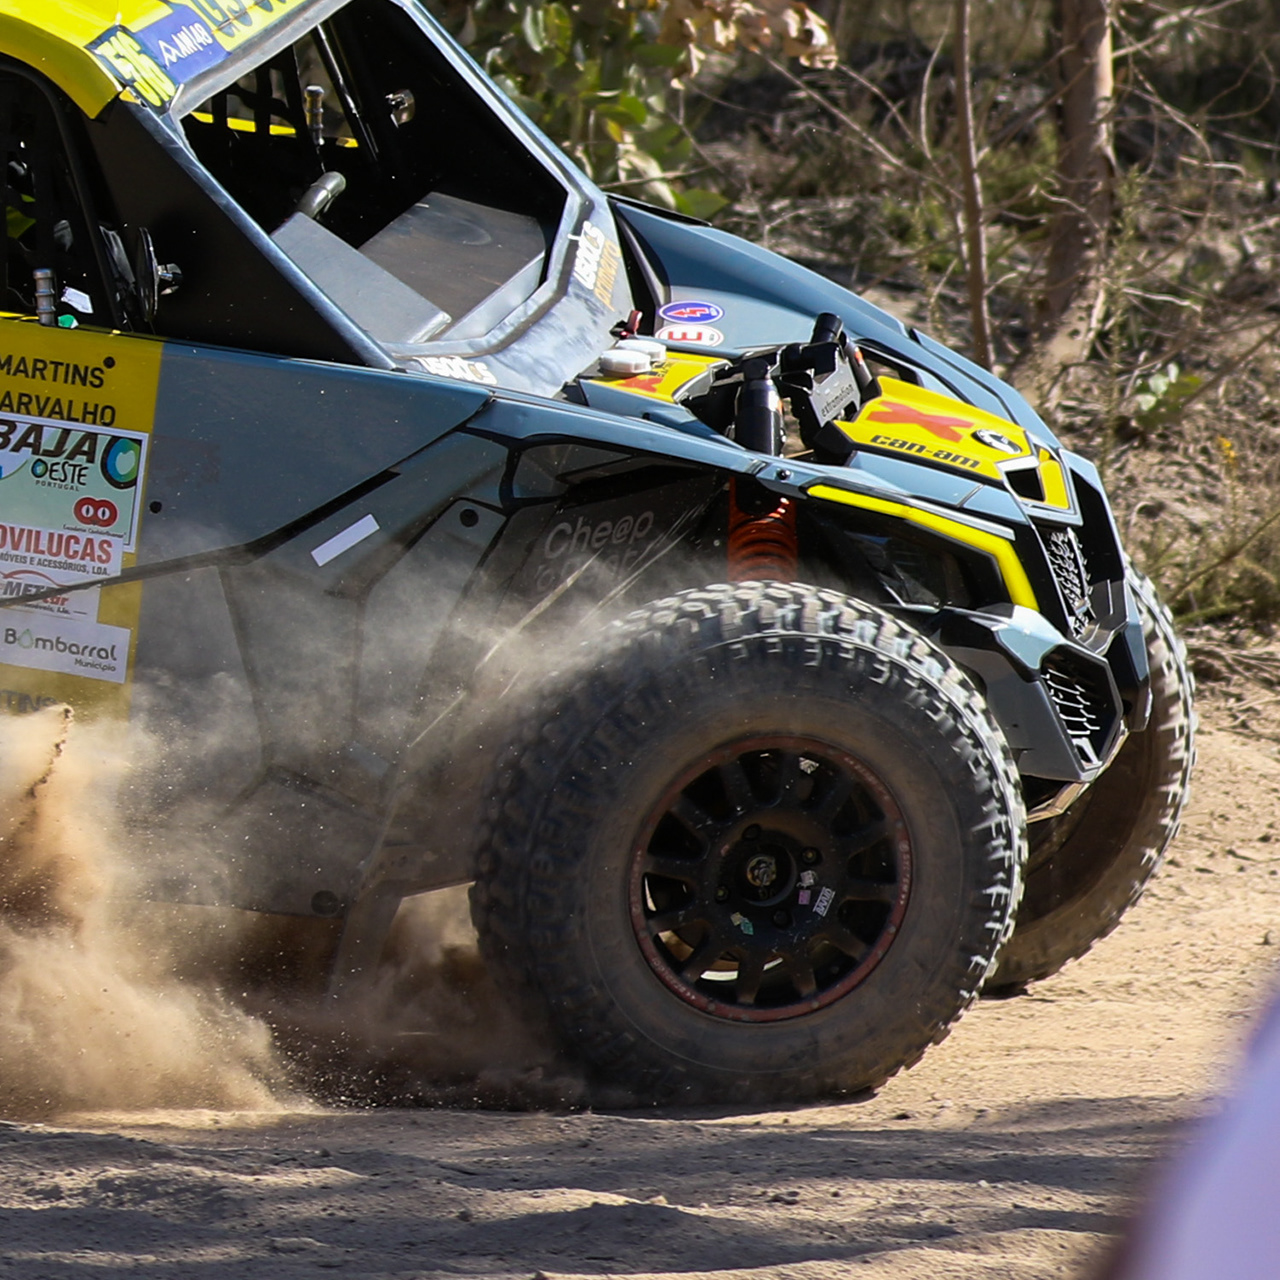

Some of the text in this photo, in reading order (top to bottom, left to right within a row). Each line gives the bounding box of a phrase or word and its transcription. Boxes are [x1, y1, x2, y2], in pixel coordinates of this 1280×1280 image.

[96, 31, 176, 107] 516
[594, 239, 622, 312] primeiro
[870, 434, 980, 469] can-am
[31, 458, 90, 486] OESTE
[35, 480, 80, 492] PORTUGAL
[29, 557, 35, 566] E
[36, 557, 89, 576] ACESSÓRIOS,
